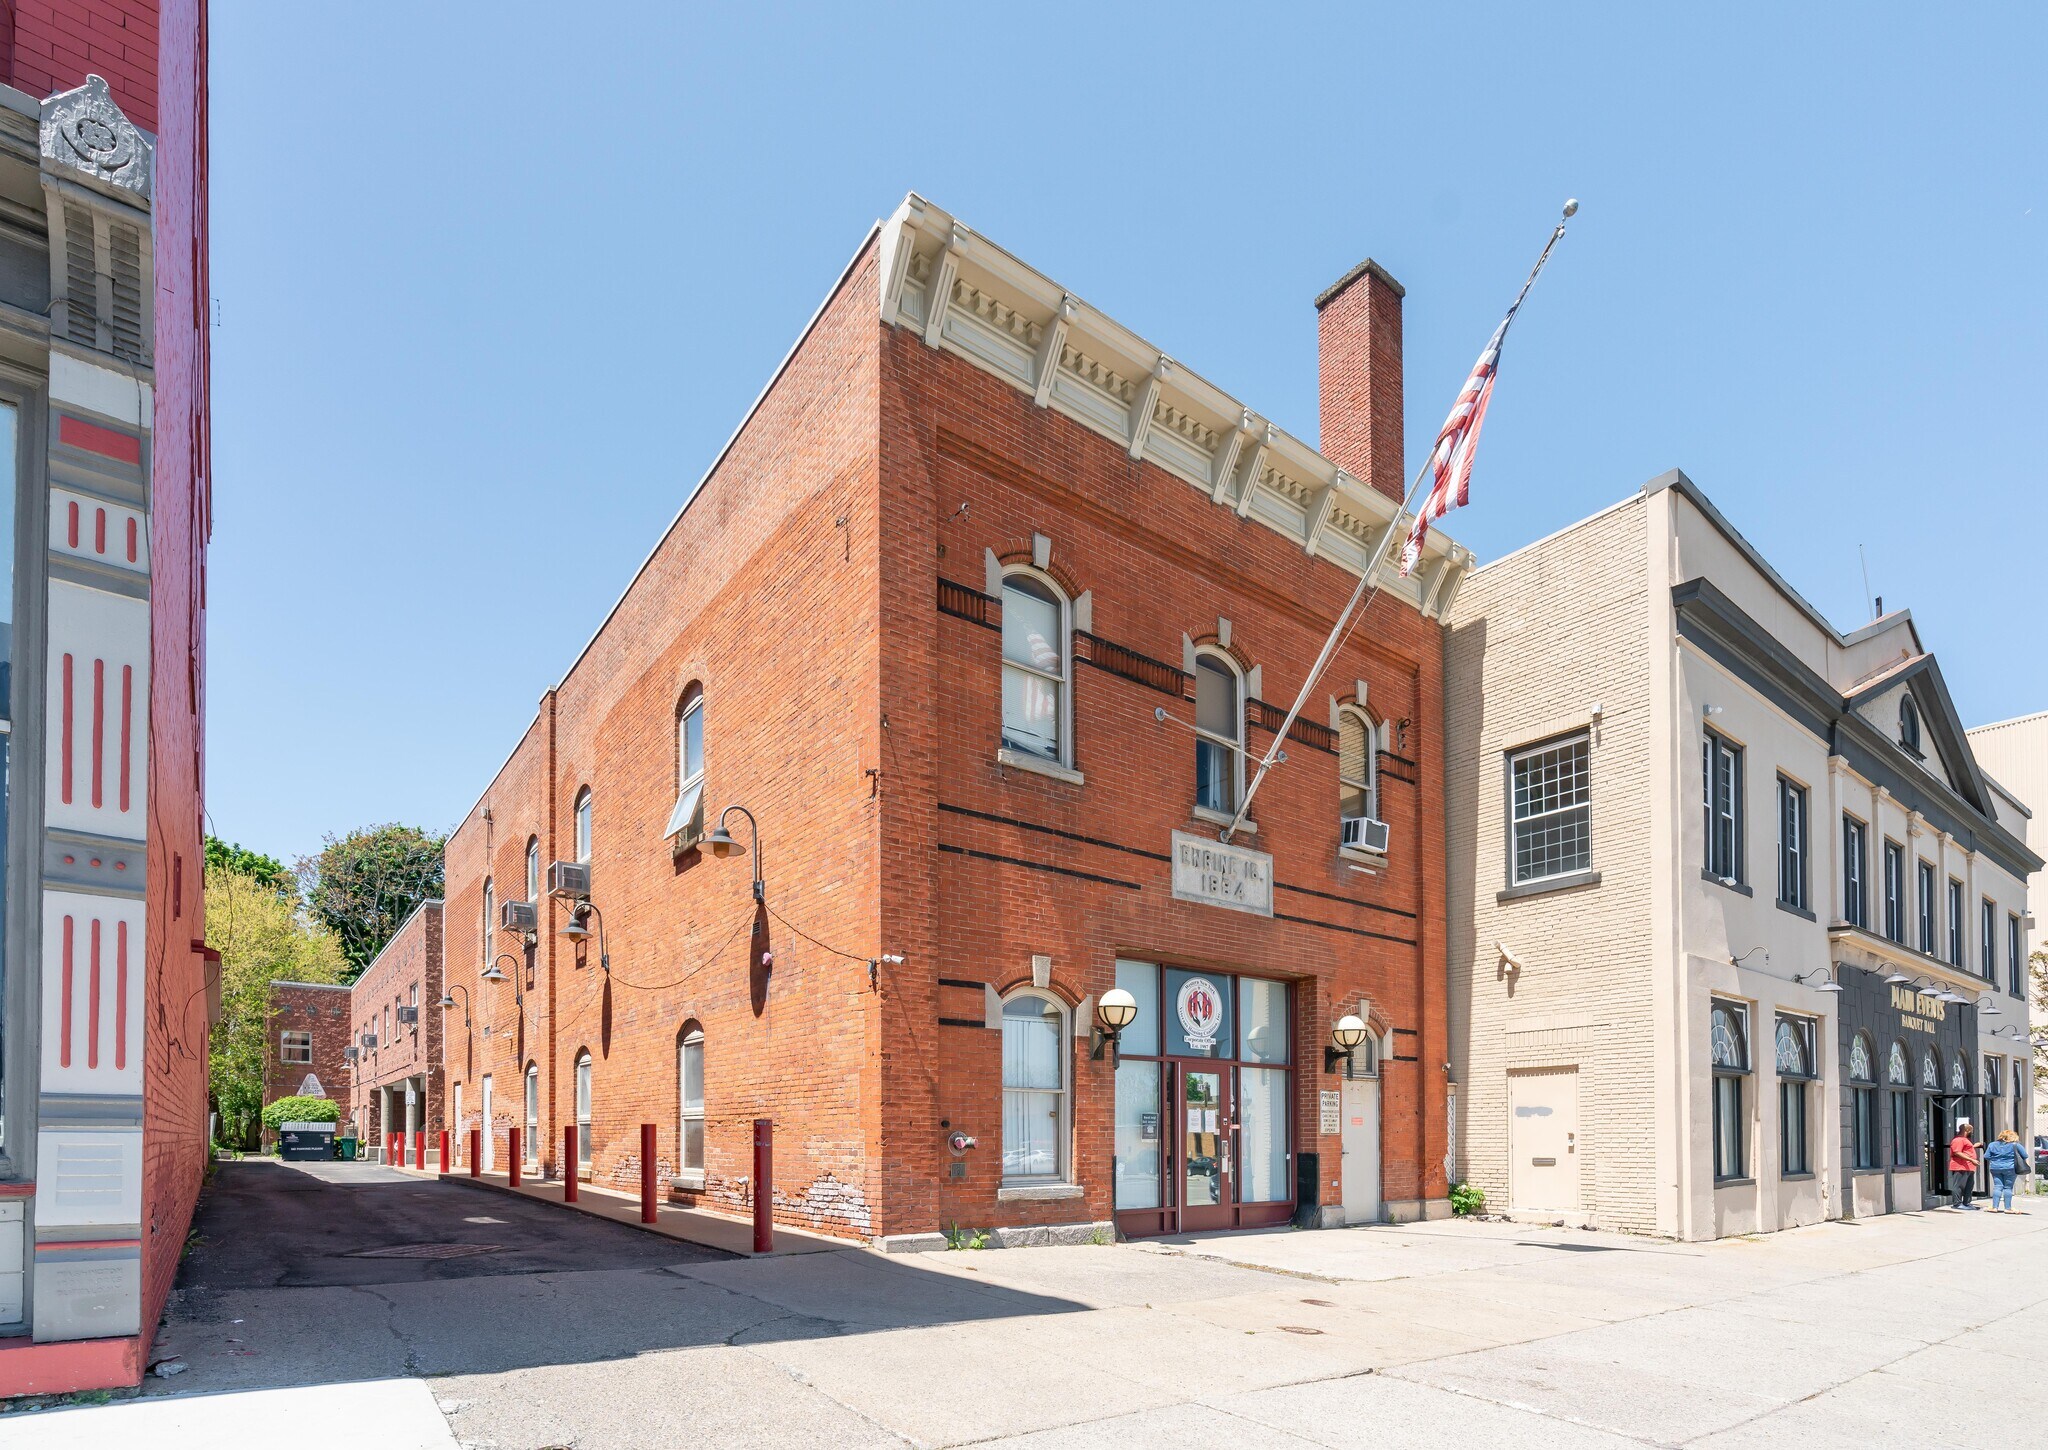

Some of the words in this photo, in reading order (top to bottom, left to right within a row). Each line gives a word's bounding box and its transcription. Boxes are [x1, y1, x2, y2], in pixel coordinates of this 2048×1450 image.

[1181, 844, 1239, 876] ENGINE
[1202, 874, 1246, 900] 1884
[1891, 985, 1915, 1012] MAIN
[1916, 993, 1945, 1021] EVENTS
[1901, 1013, 1924, 1031] BANQUET
[1321, 1092, 1339, 1100] PRIVATE
[1322, 1100, 1338, 1108] PARKING
